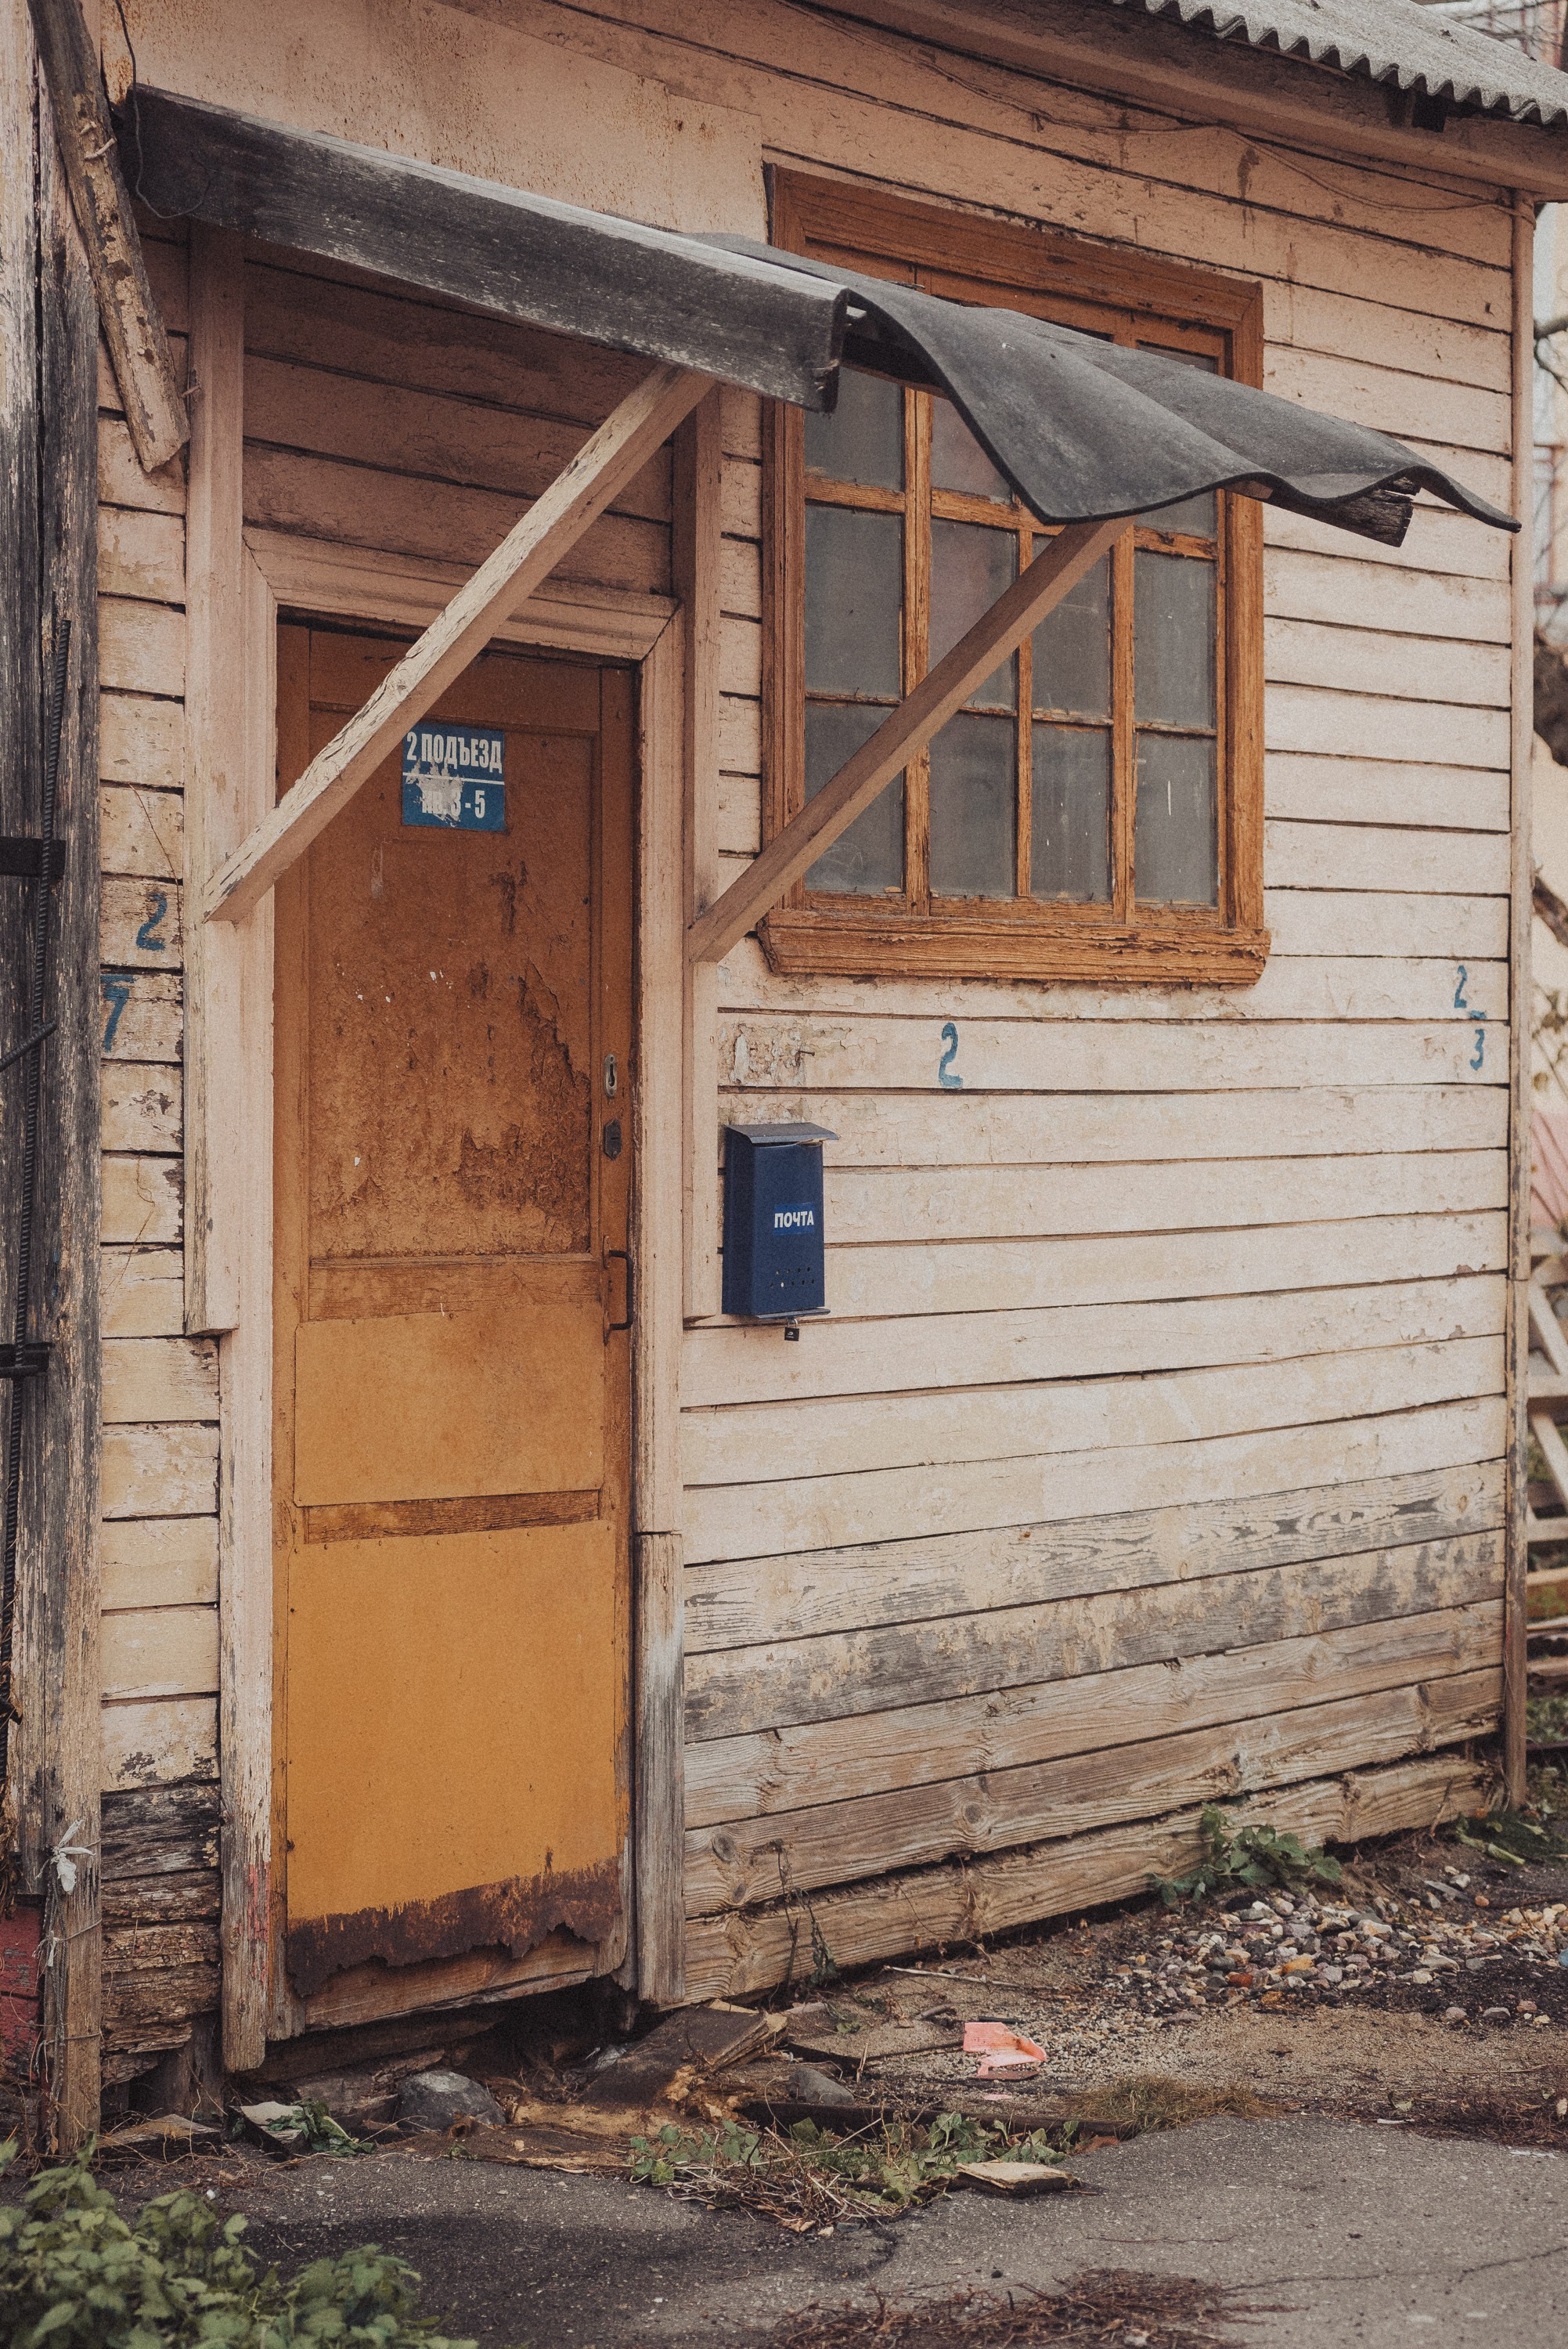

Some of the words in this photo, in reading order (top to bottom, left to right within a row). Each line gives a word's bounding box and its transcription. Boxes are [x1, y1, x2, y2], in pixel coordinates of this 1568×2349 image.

[406, 731, 417, 760] 2
[421, 733, 503, 774] ПОДЪЕЗД
[135, 892, 168, 951] 2
[1454, 965, 1468, 1009] 2
[103, 985, 130, 1052] 7
[939, 1022, 964, 1089] 2
[1469, 1028, 1485, 1070] 3
[774, 1211, 814, 1229] ПОЧТА
